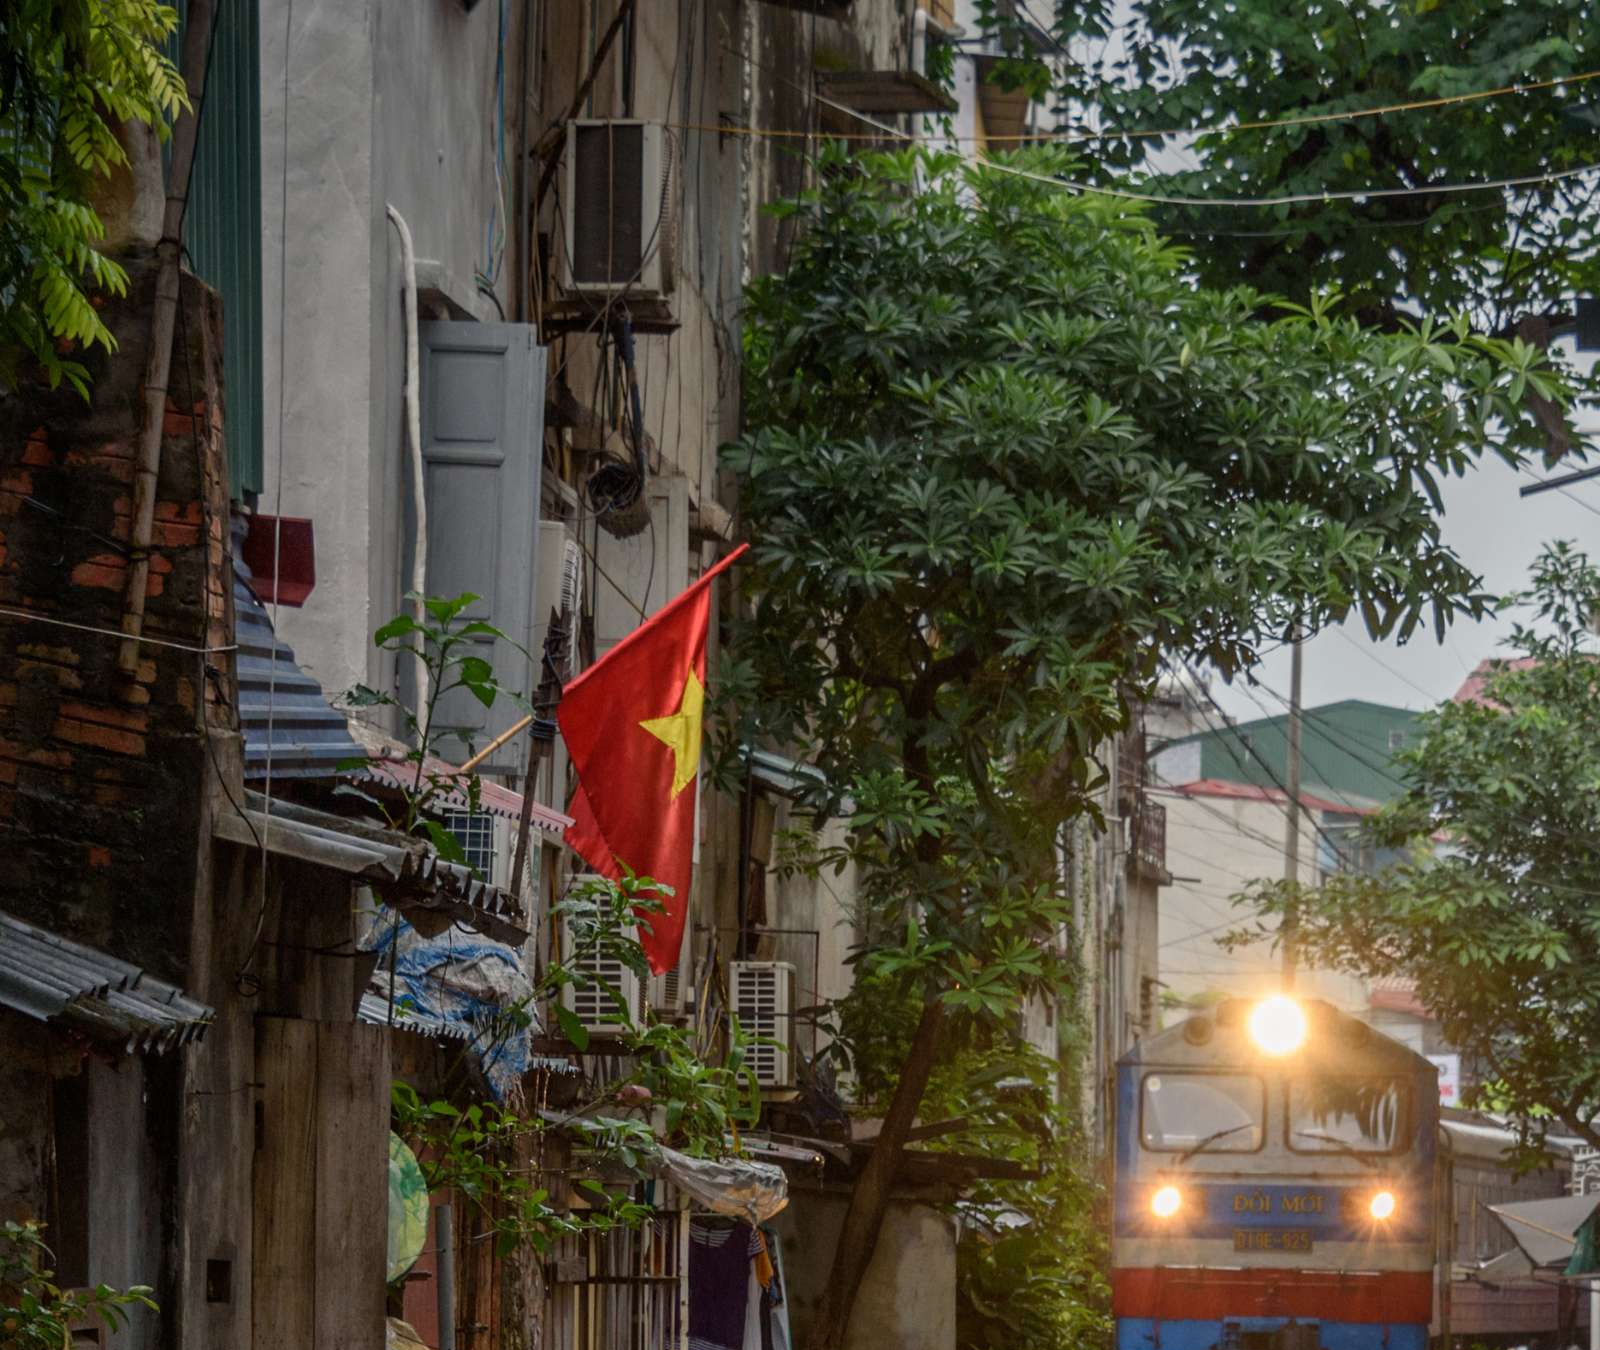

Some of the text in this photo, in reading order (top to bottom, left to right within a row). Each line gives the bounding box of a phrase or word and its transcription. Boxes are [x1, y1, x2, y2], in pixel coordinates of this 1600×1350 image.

[1233, 1187, 1324, 1214] ĐỔI MỚI
[1236, 1231, 1310, 1251] D19E-925
